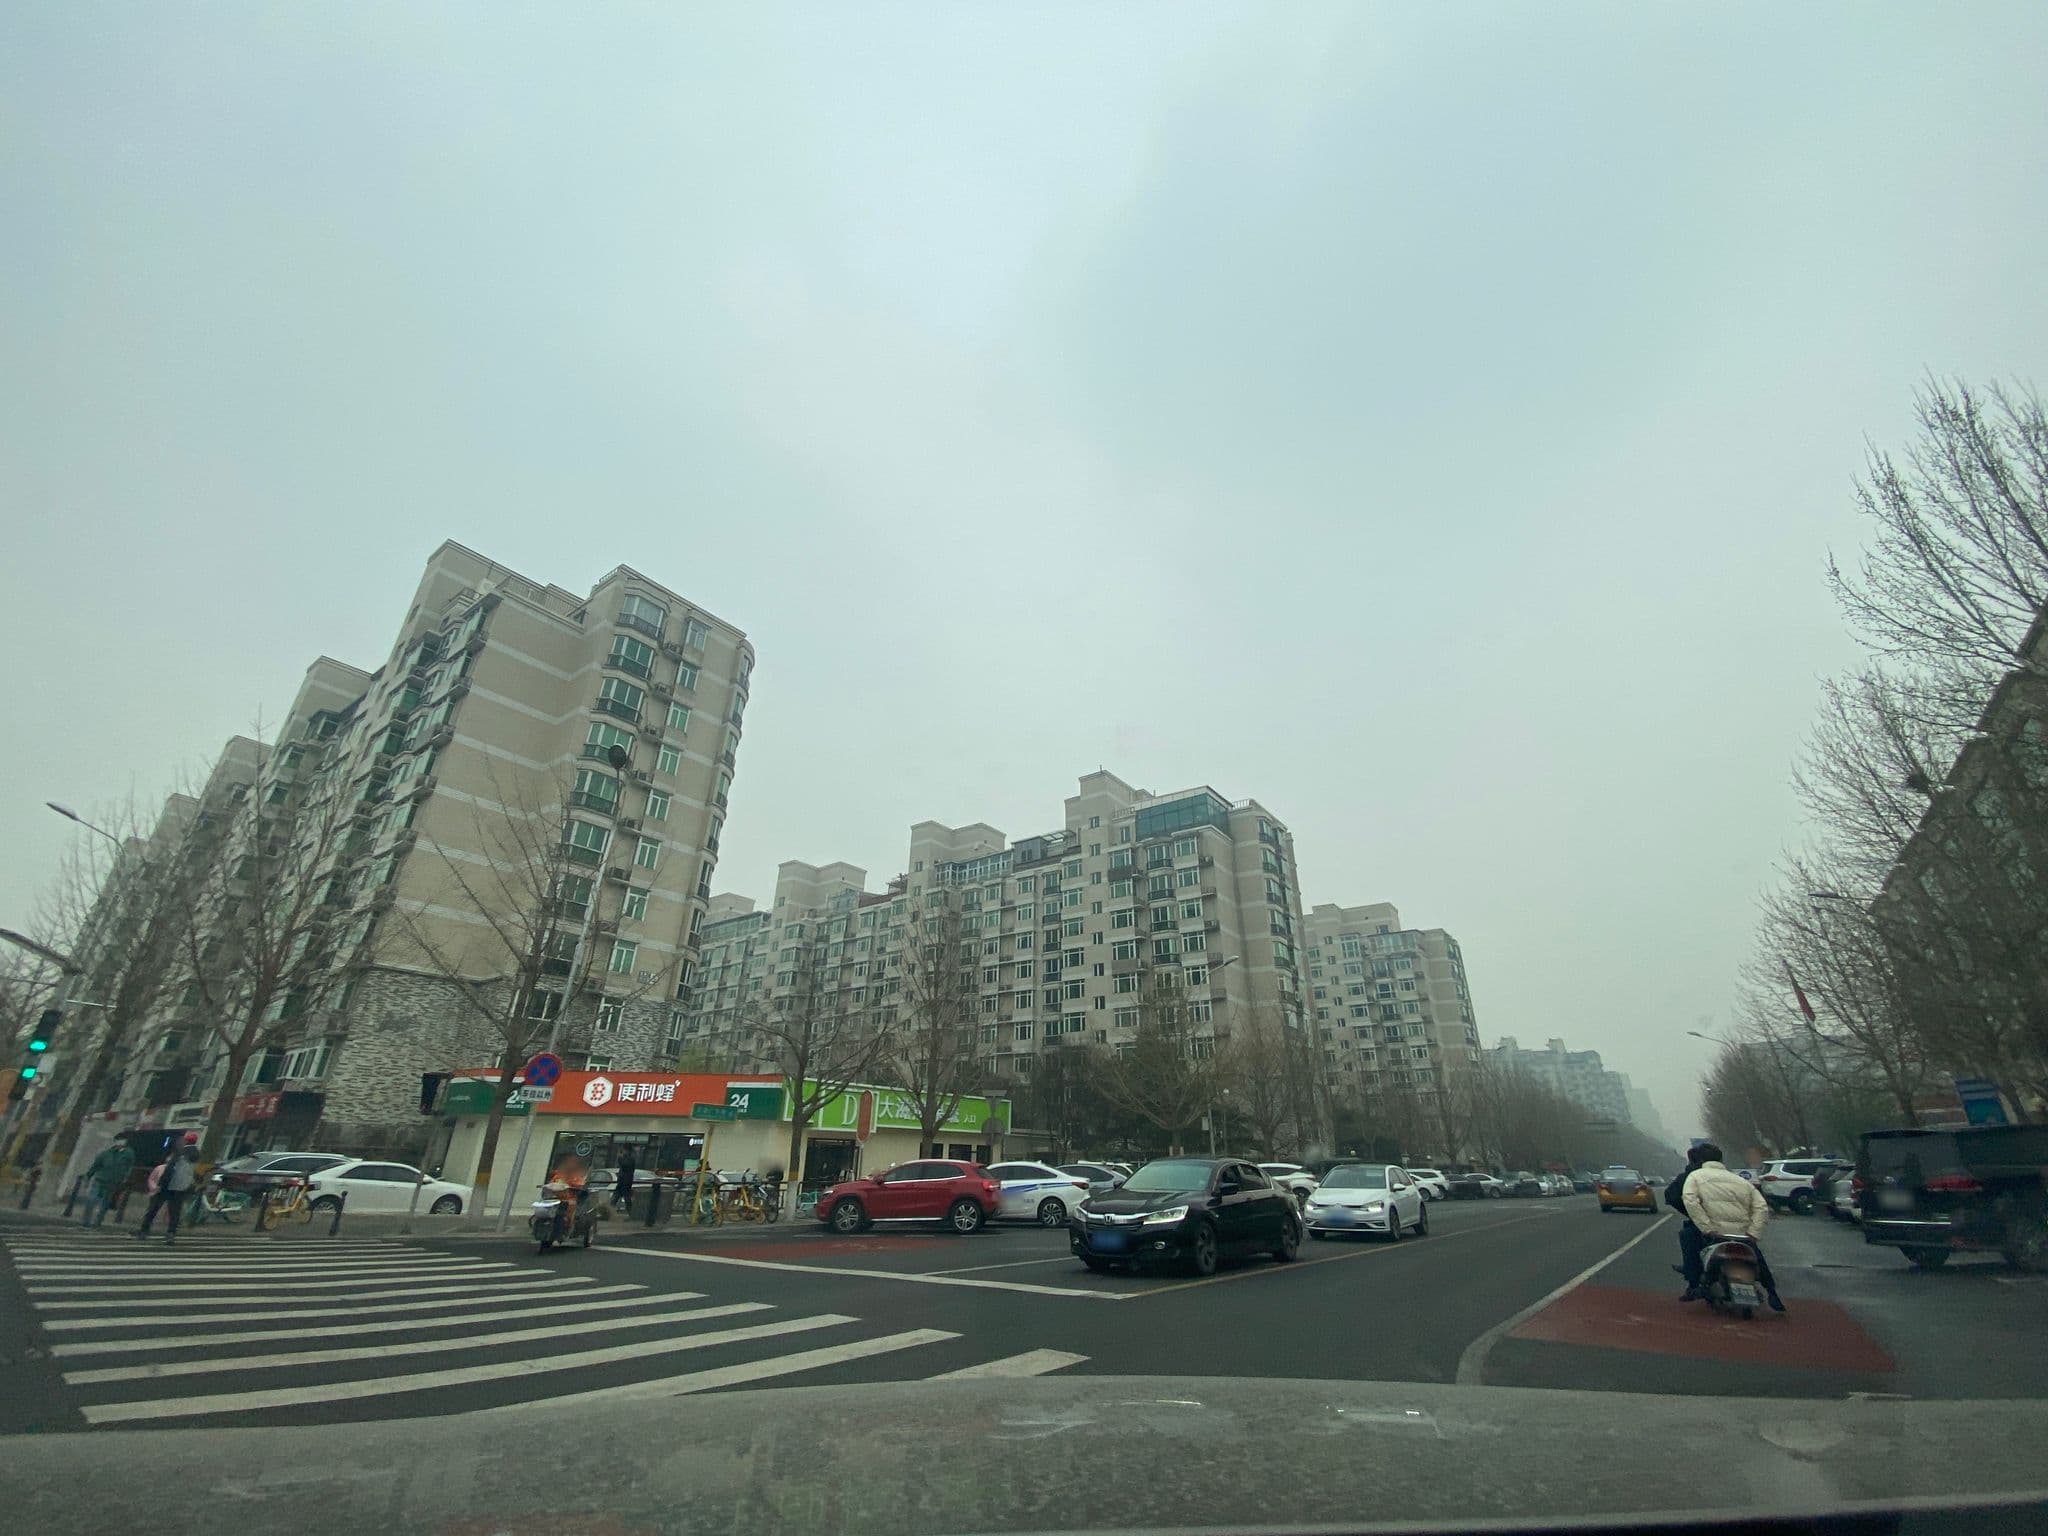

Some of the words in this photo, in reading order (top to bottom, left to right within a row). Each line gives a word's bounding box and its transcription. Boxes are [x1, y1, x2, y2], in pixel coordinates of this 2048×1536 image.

[617, 1082, 676, 1103] 便利蜂
[730, 1093, 749, 1108] 24
